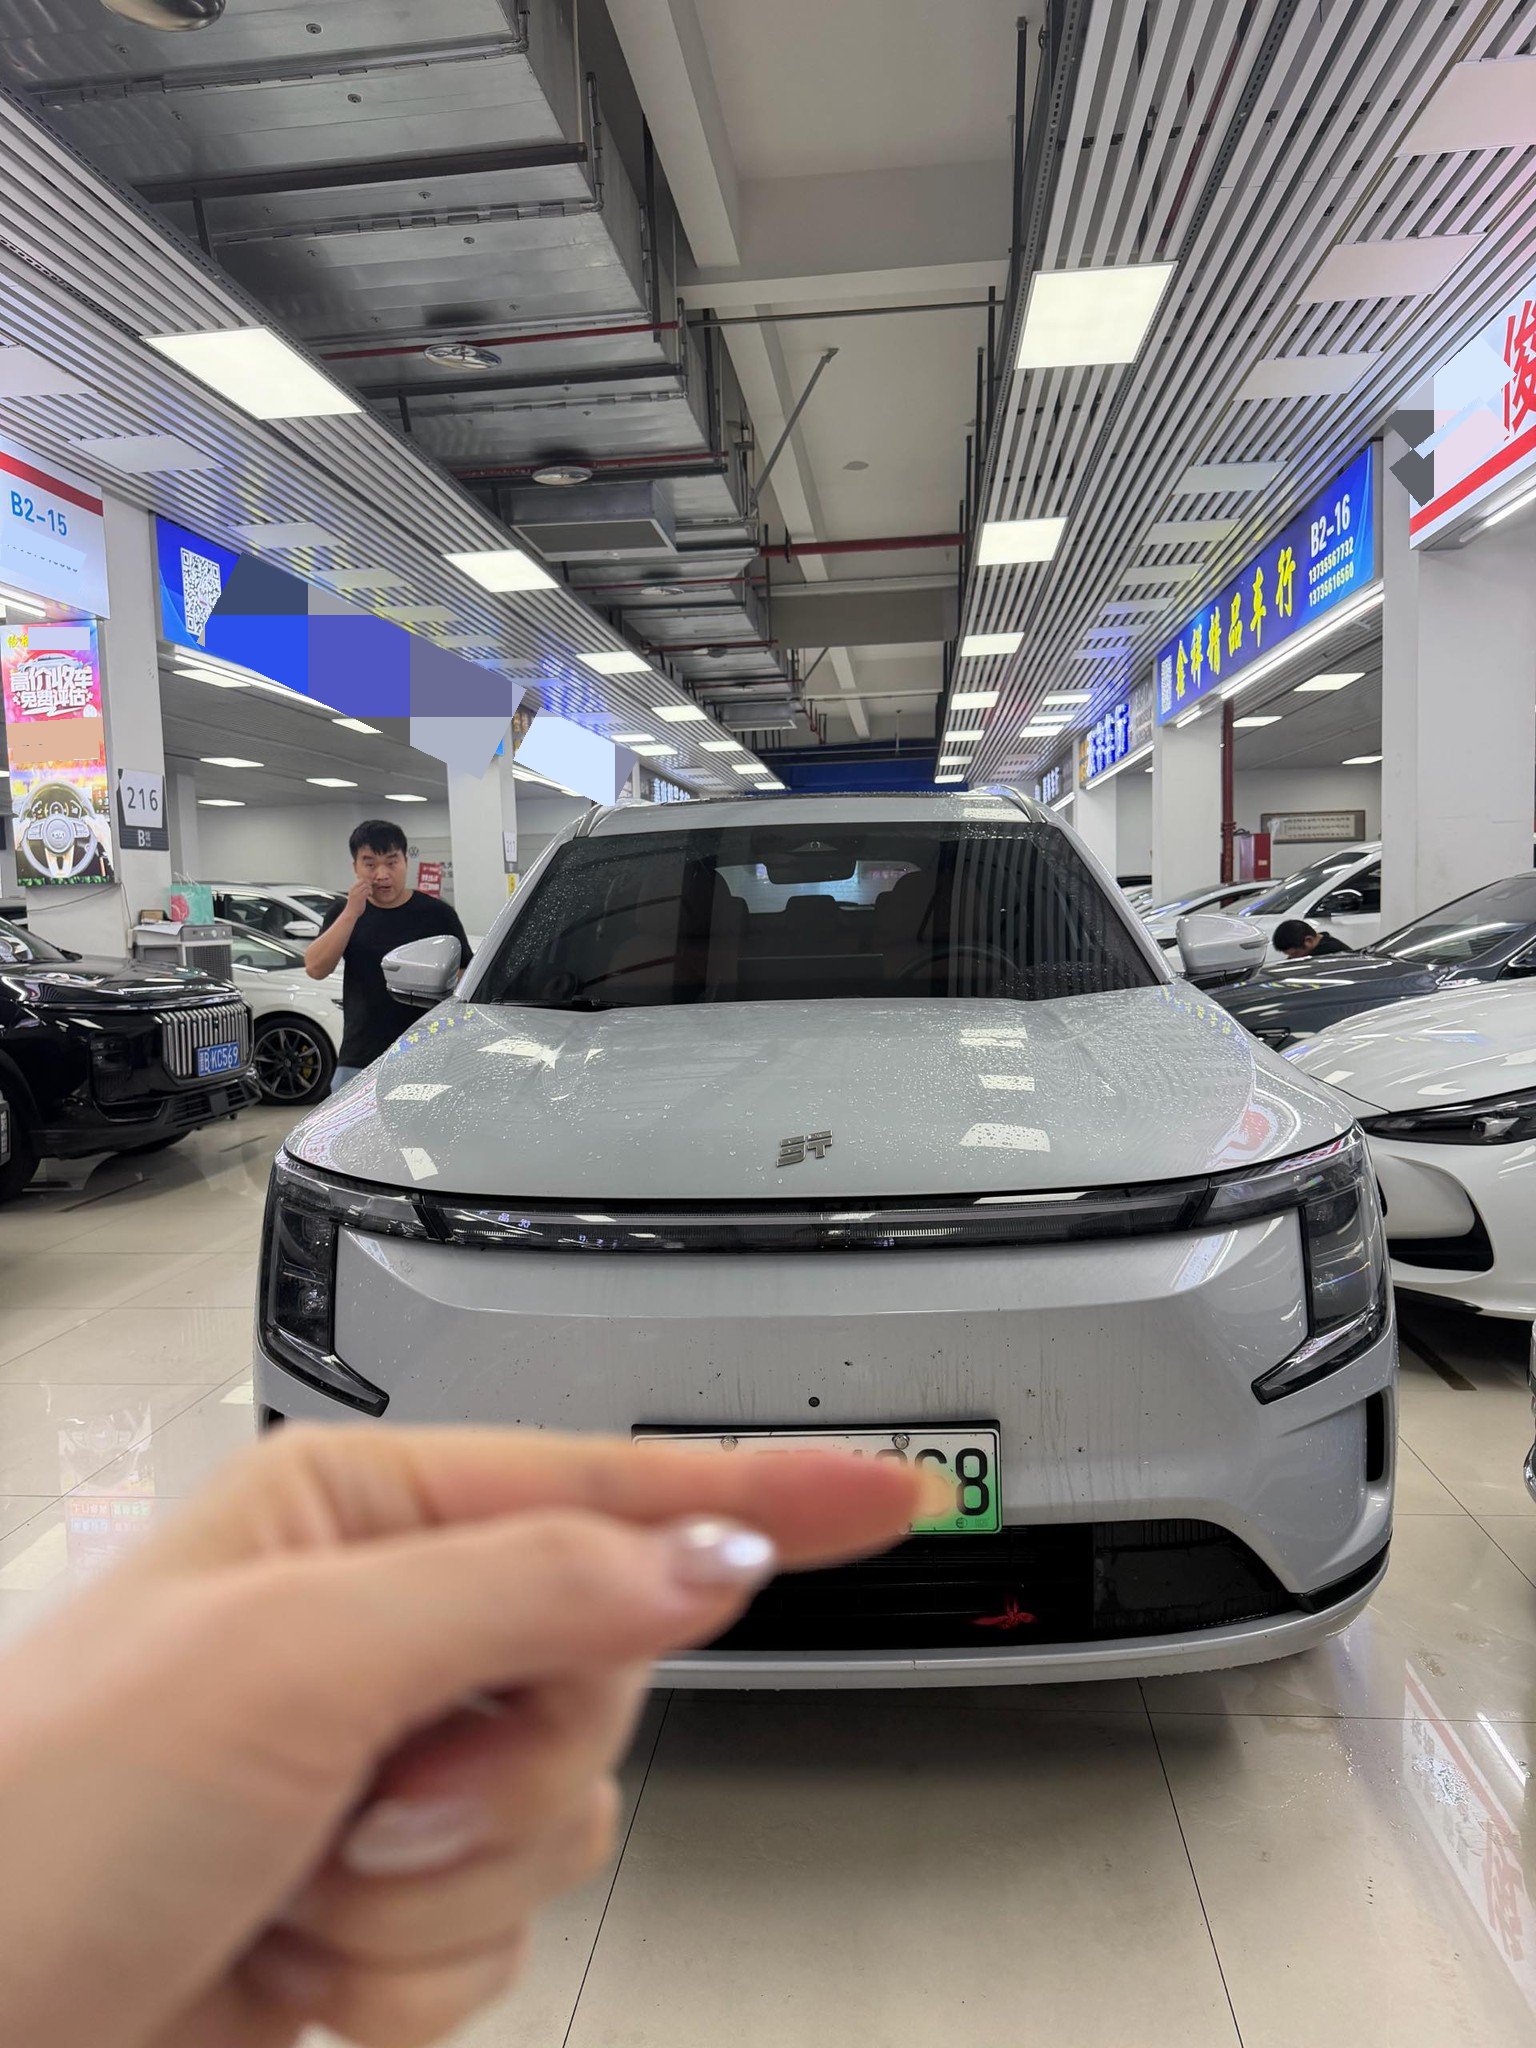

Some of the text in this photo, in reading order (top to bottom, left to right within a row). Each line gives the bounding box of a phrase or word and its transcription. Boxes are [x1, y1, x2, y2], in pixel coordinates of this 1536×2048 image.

[10, 490, 68, 536] B2-15
[1310, 493, 1350, 558] B2-16
[10, 665, 94, 693] 高价收车
[20, 687, 87, 709] 免费评估
[127, 786, 158, 811] 216
